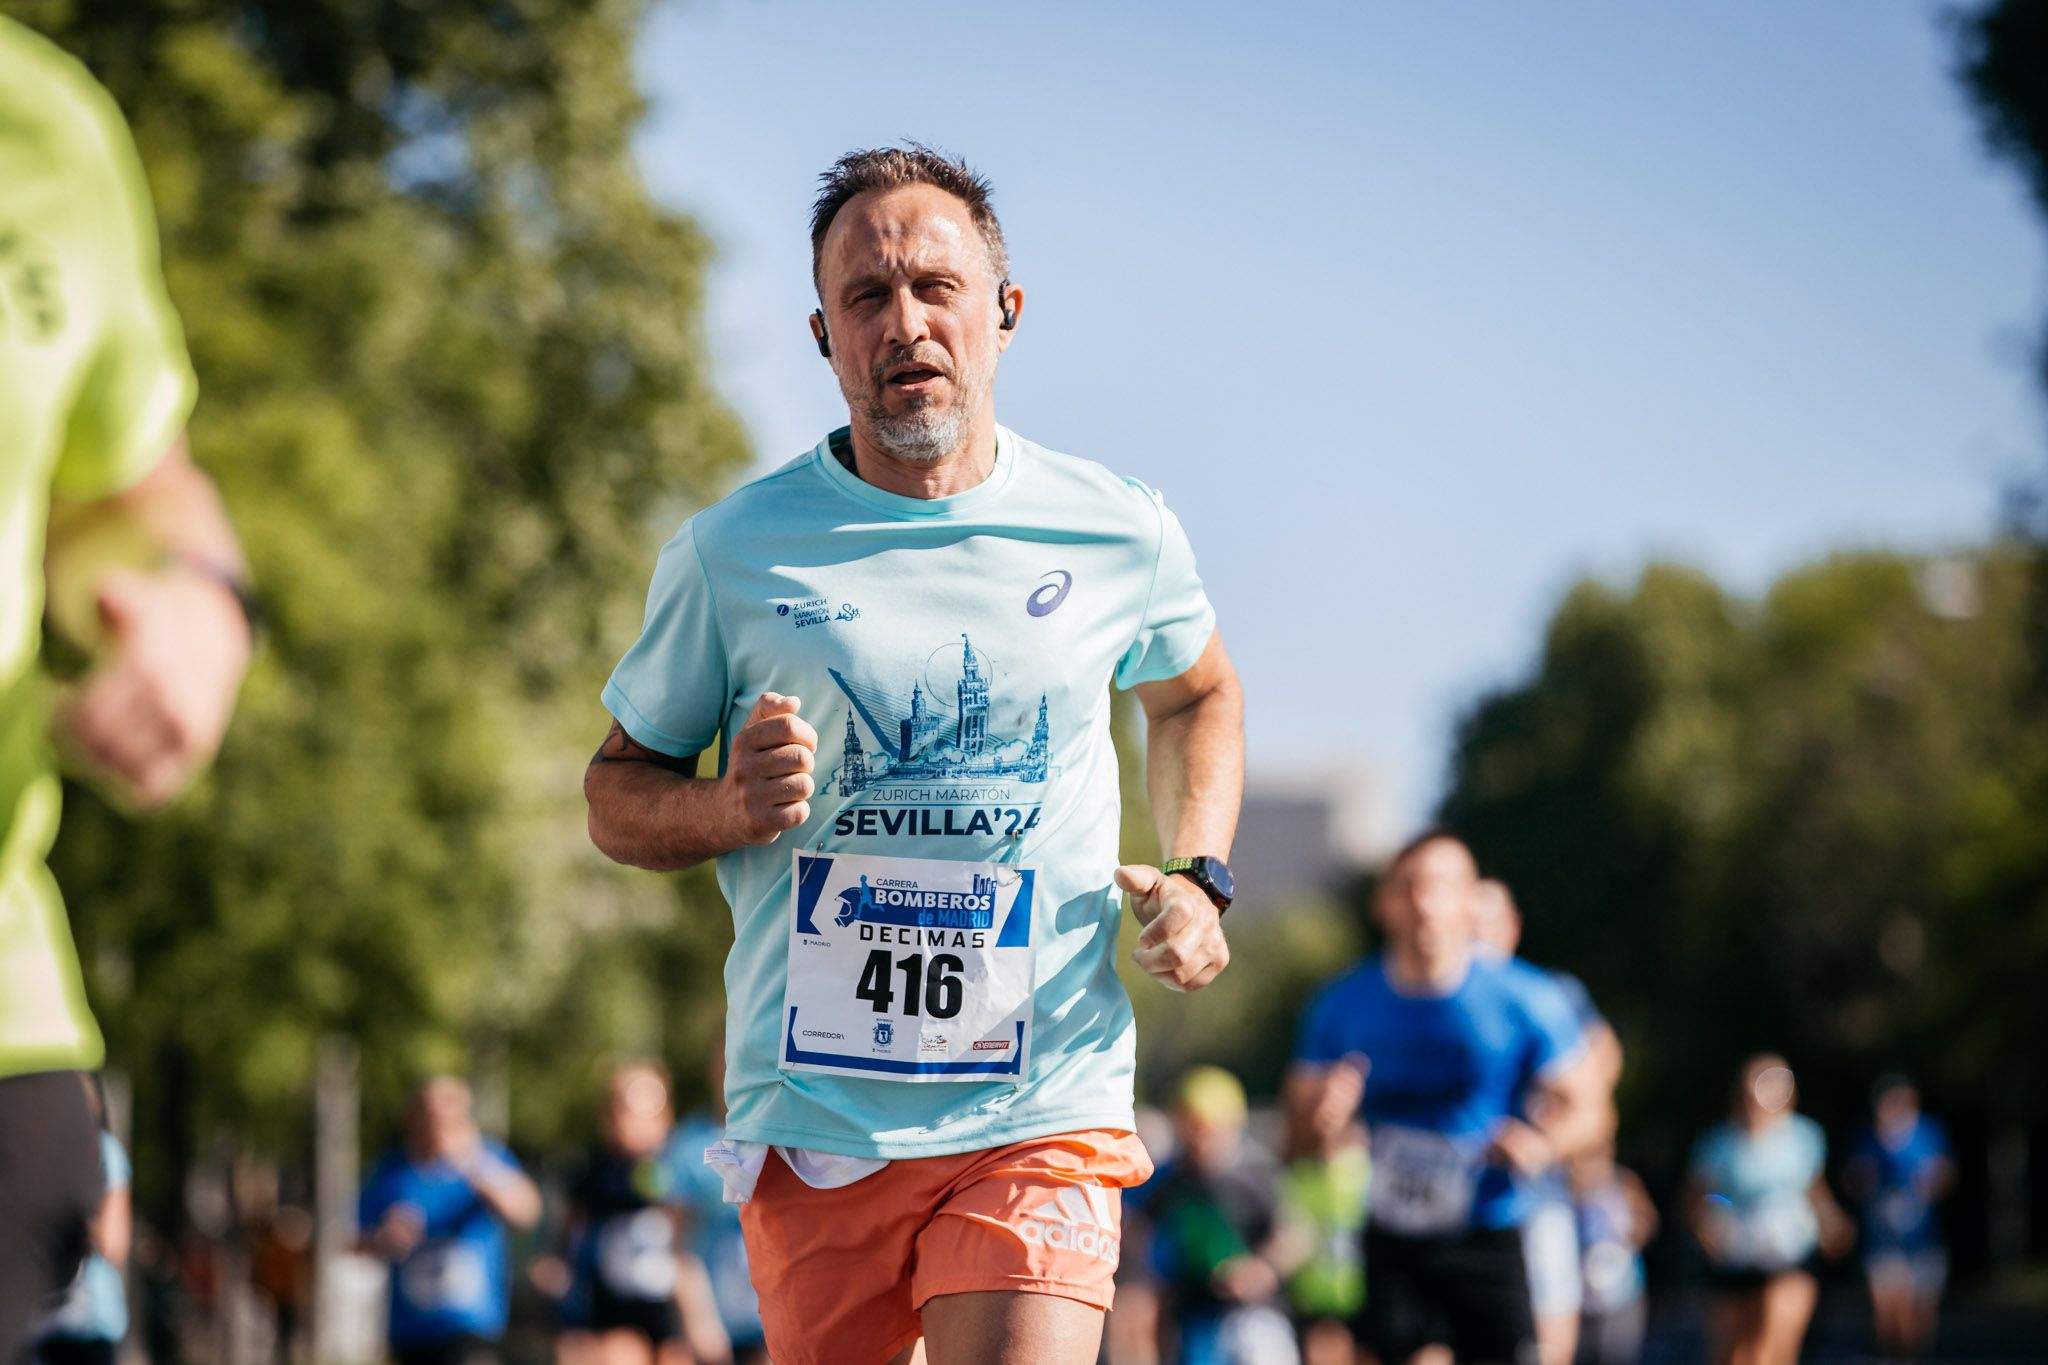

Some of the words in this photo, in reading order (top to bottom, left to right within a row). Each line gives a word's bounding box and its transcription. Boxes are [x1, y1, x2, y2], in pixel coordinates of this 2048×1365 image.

[793, 598, 827, 610] ZURICH
[795, 615, 831, 628] SEVILLA
[873, 788, 930, 801] ZURICH
[936, 786, 1010, 800] MARATÓN
[876, 878, 919, 889] CARRERA
[874, 889, 991, 911] BOMBEROS
[918, 909, 934, 925] de
[939, 910, 990, 928] MADRID
[860, 924, 985, 949] DECIMAS
[856, 949, 964, 1019] 416
